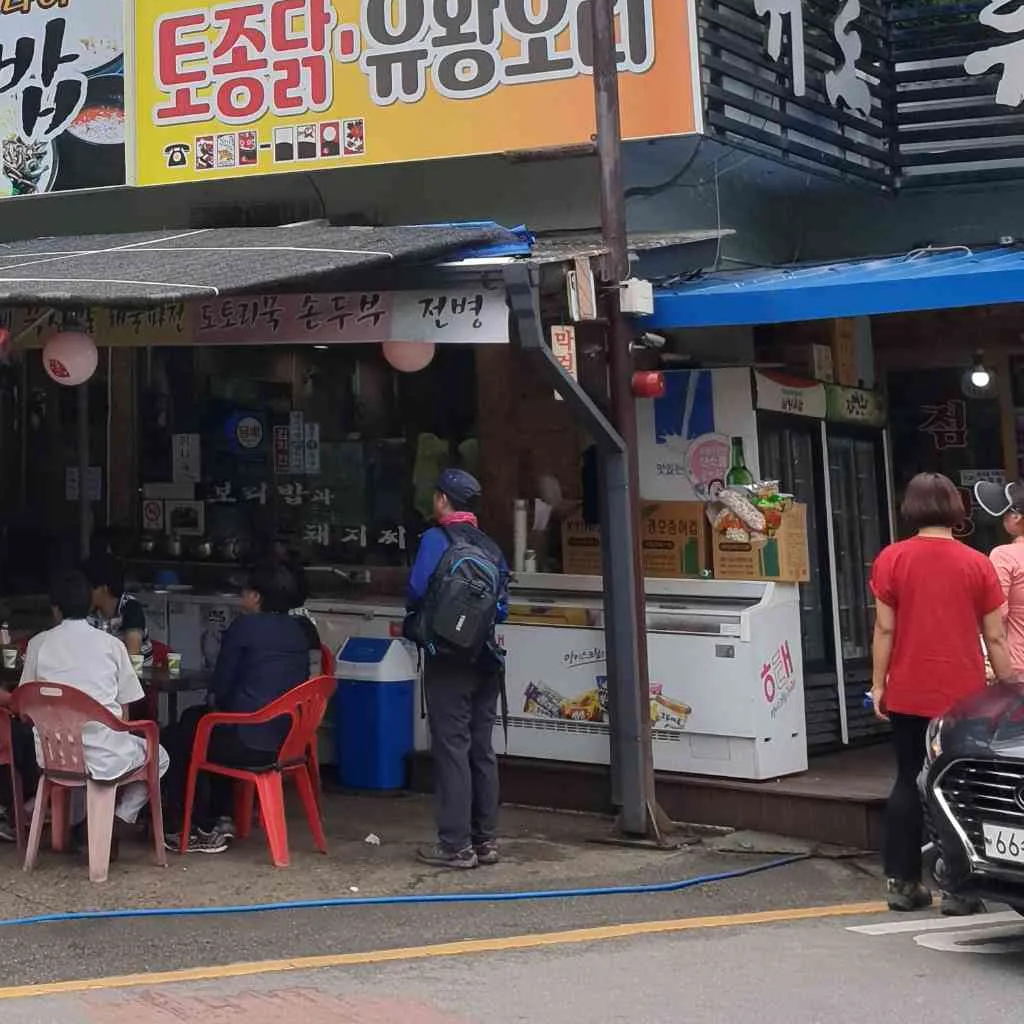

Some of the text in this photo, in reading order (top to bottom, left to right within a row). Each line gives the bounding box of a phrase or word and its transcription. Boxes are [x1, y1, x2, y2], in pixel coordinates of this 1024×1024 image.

[199, 293, 386, 331] 도토리묵 손두부
[418, 293, 484, 330] 전병
